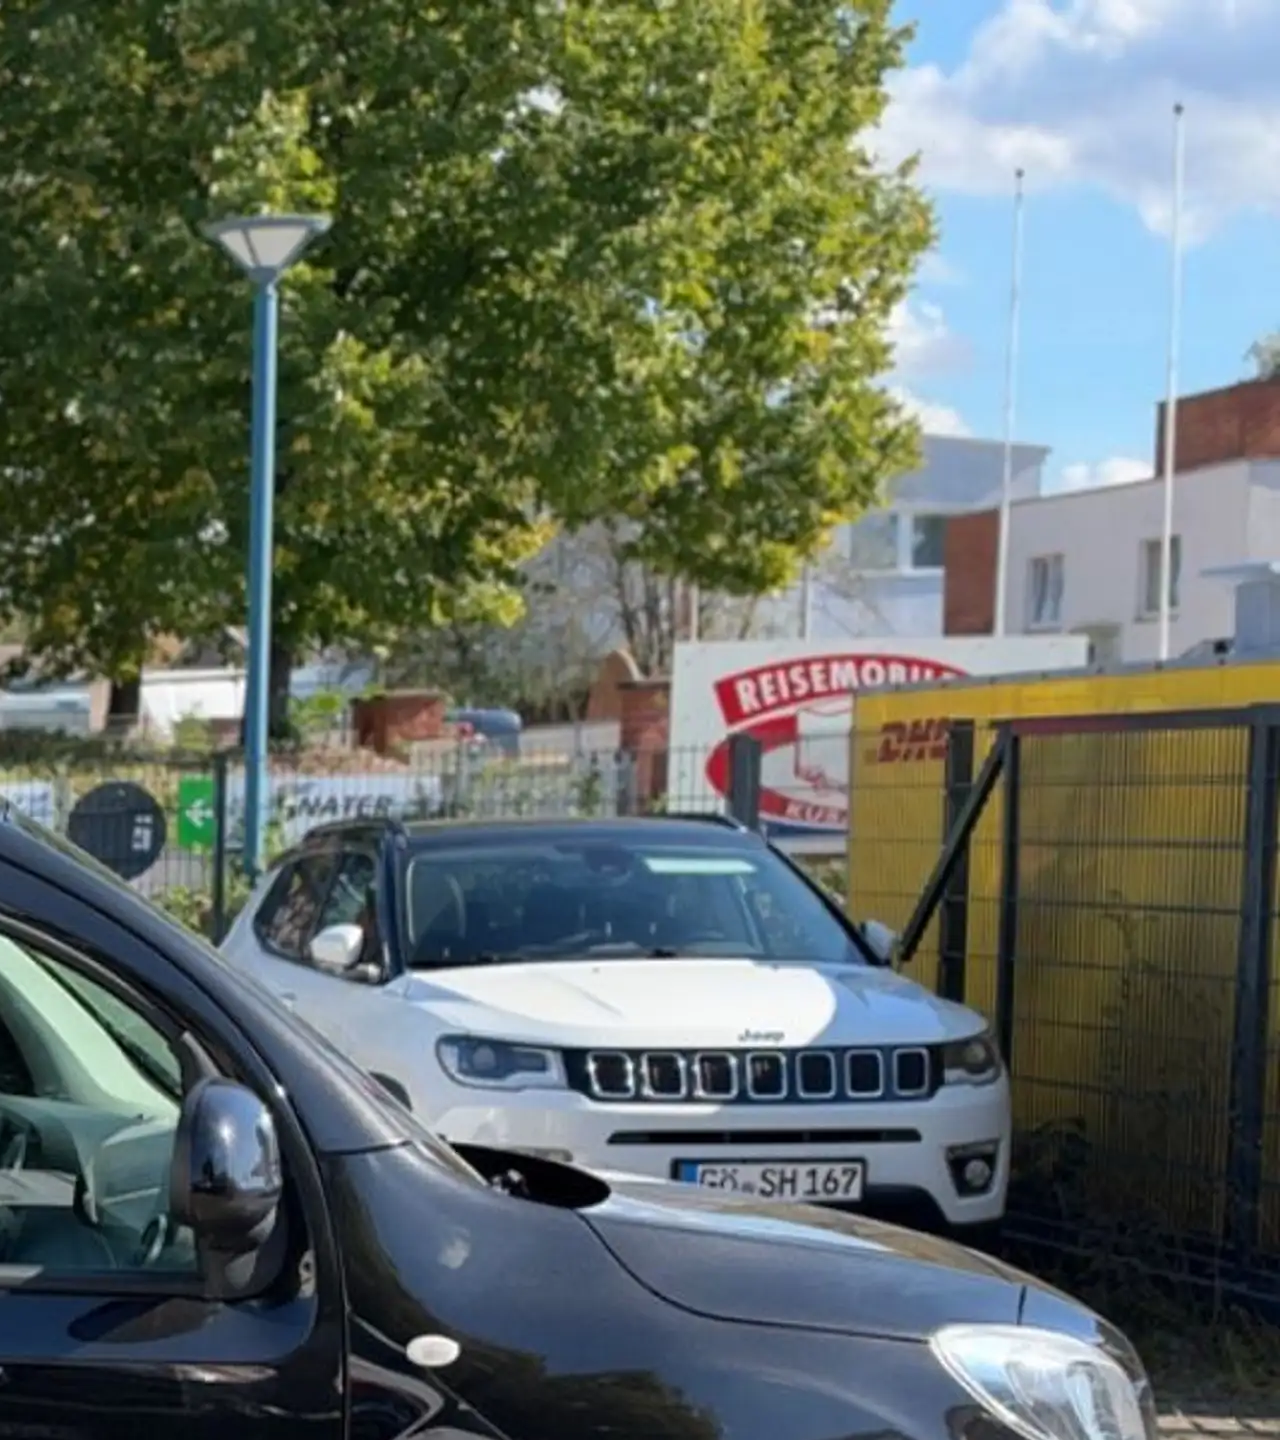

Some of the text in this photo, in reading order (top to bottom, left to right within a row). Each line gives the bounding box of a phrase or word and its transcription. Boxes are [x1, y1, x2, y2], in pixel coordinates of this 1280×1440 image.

[735, 660, 958, 715] REISEMOBI
[759, 1168, 799, 1198] SH
[803, 1168, 859, 1198] 167
